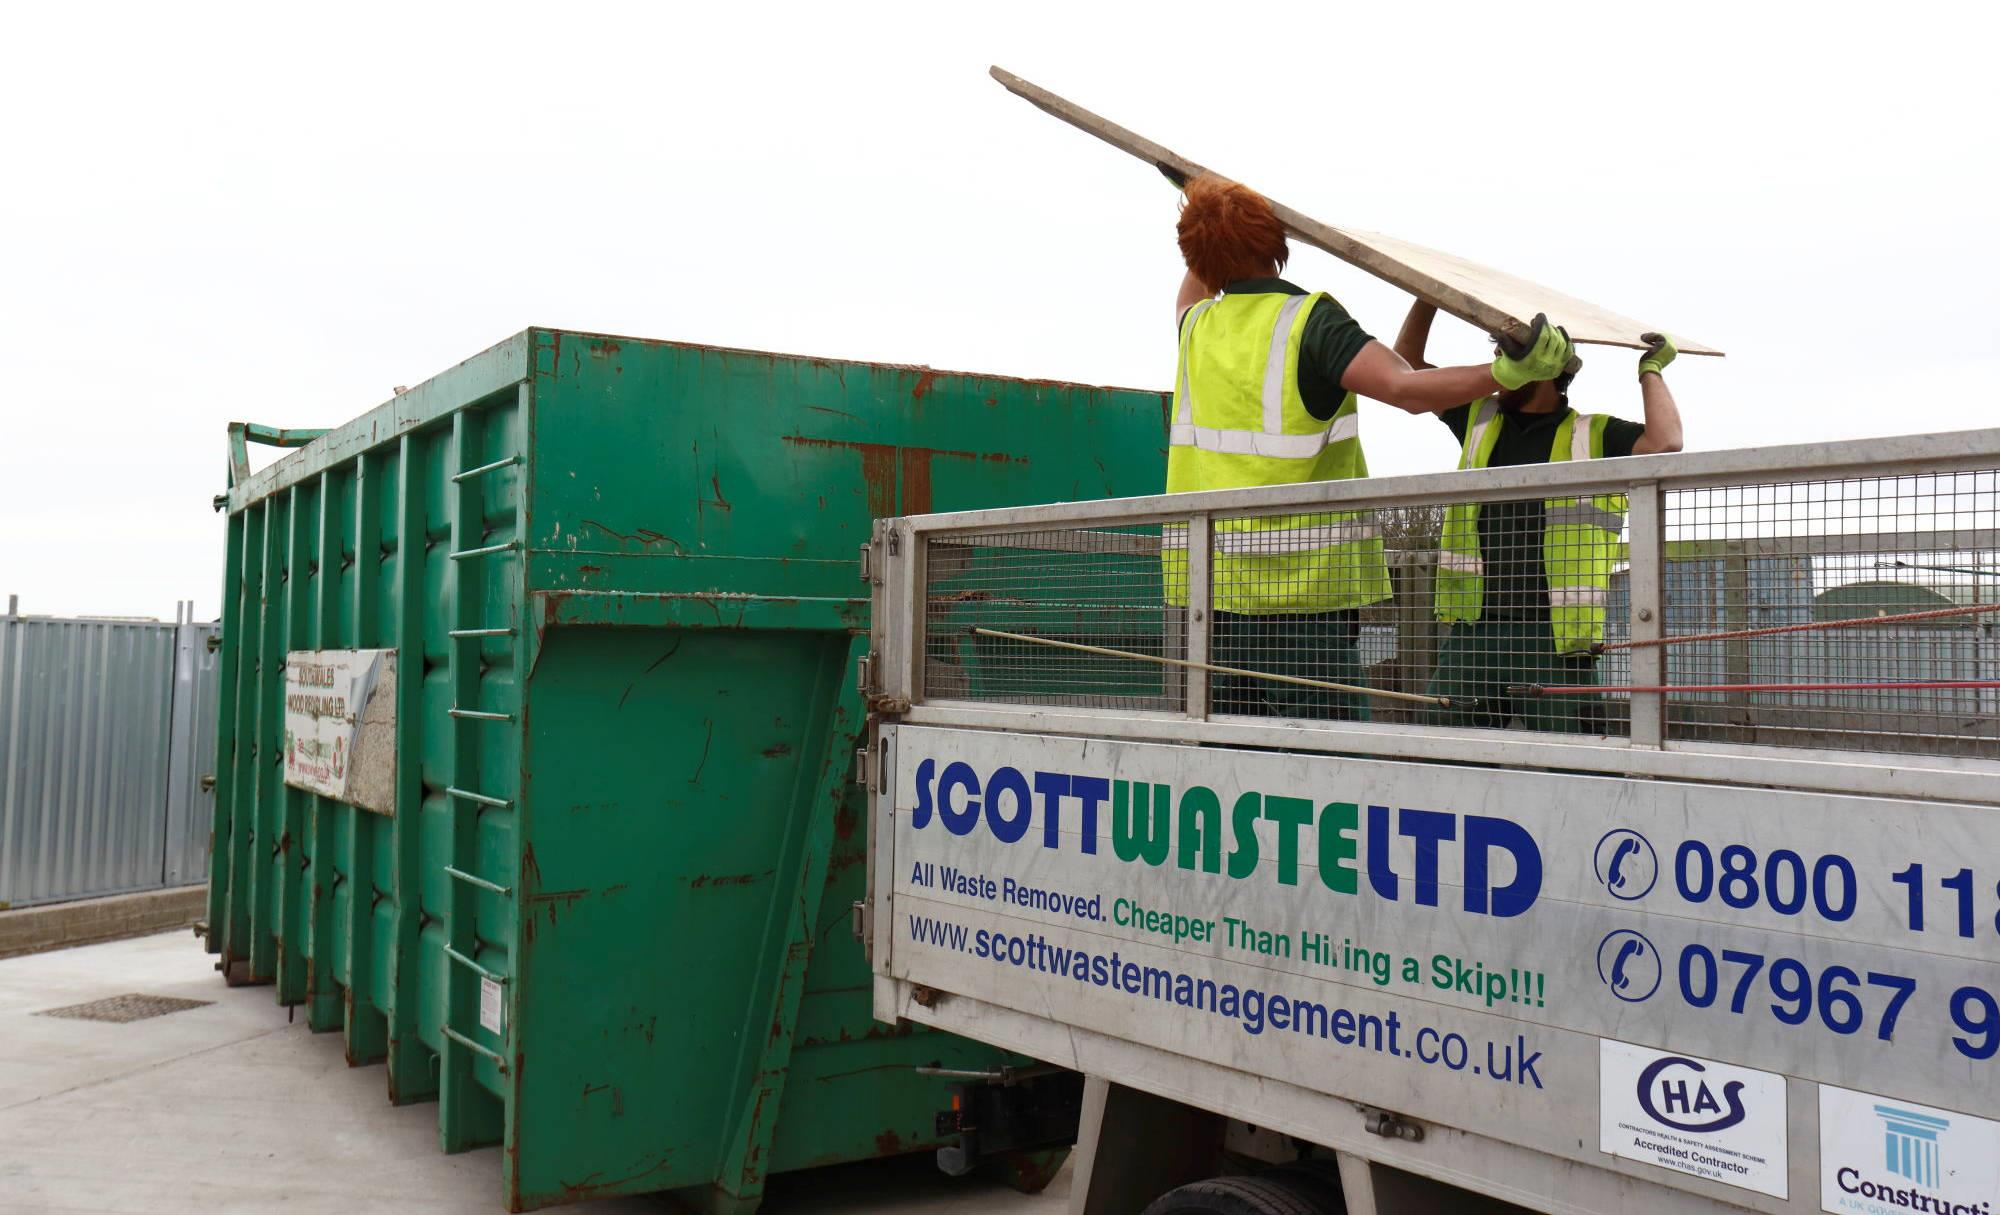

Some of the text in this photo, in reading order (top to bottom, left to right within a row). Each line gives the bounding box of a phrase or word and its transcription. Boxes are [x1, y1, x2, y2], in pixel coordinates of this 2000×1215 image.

[1675, 840, 1857, 922] 0800
[911, 861, 934, 888] All
[940, 866, 997, 900] Waste
[1003, 877, 1107, 922] Removed.
[1113, 897, 1216, 944] Cheaper
[1223, 917, 1291, 958] Than
[1402, 957, 1420, 983] a
[1431, 954, 1545, 1008] Skip!!!
[910, 914, 1544, 1089] www.scottwastemanagement.co.uk
[1678, 944, 1917, 1042] 07967
[1637, 1056, 1745, 1133] CHAS
[1618, 1122, 1657, 1137] CONTRACTORS
[1657, 1132, 1678, 1142] HEALTH
[1683, 1138, 1704, 1149] SAFETY
[1704, 1143, 1742, 1158] ASSESSMENT
[1742, 1153, 1766, 1165] SCHEME
[1633, 1137, 1749, 1175] Accredited Contractor
[1657, 1156, 1723, 1179] www.chas.gov.uk
[1848, 1199, 1864, 1211] UK
